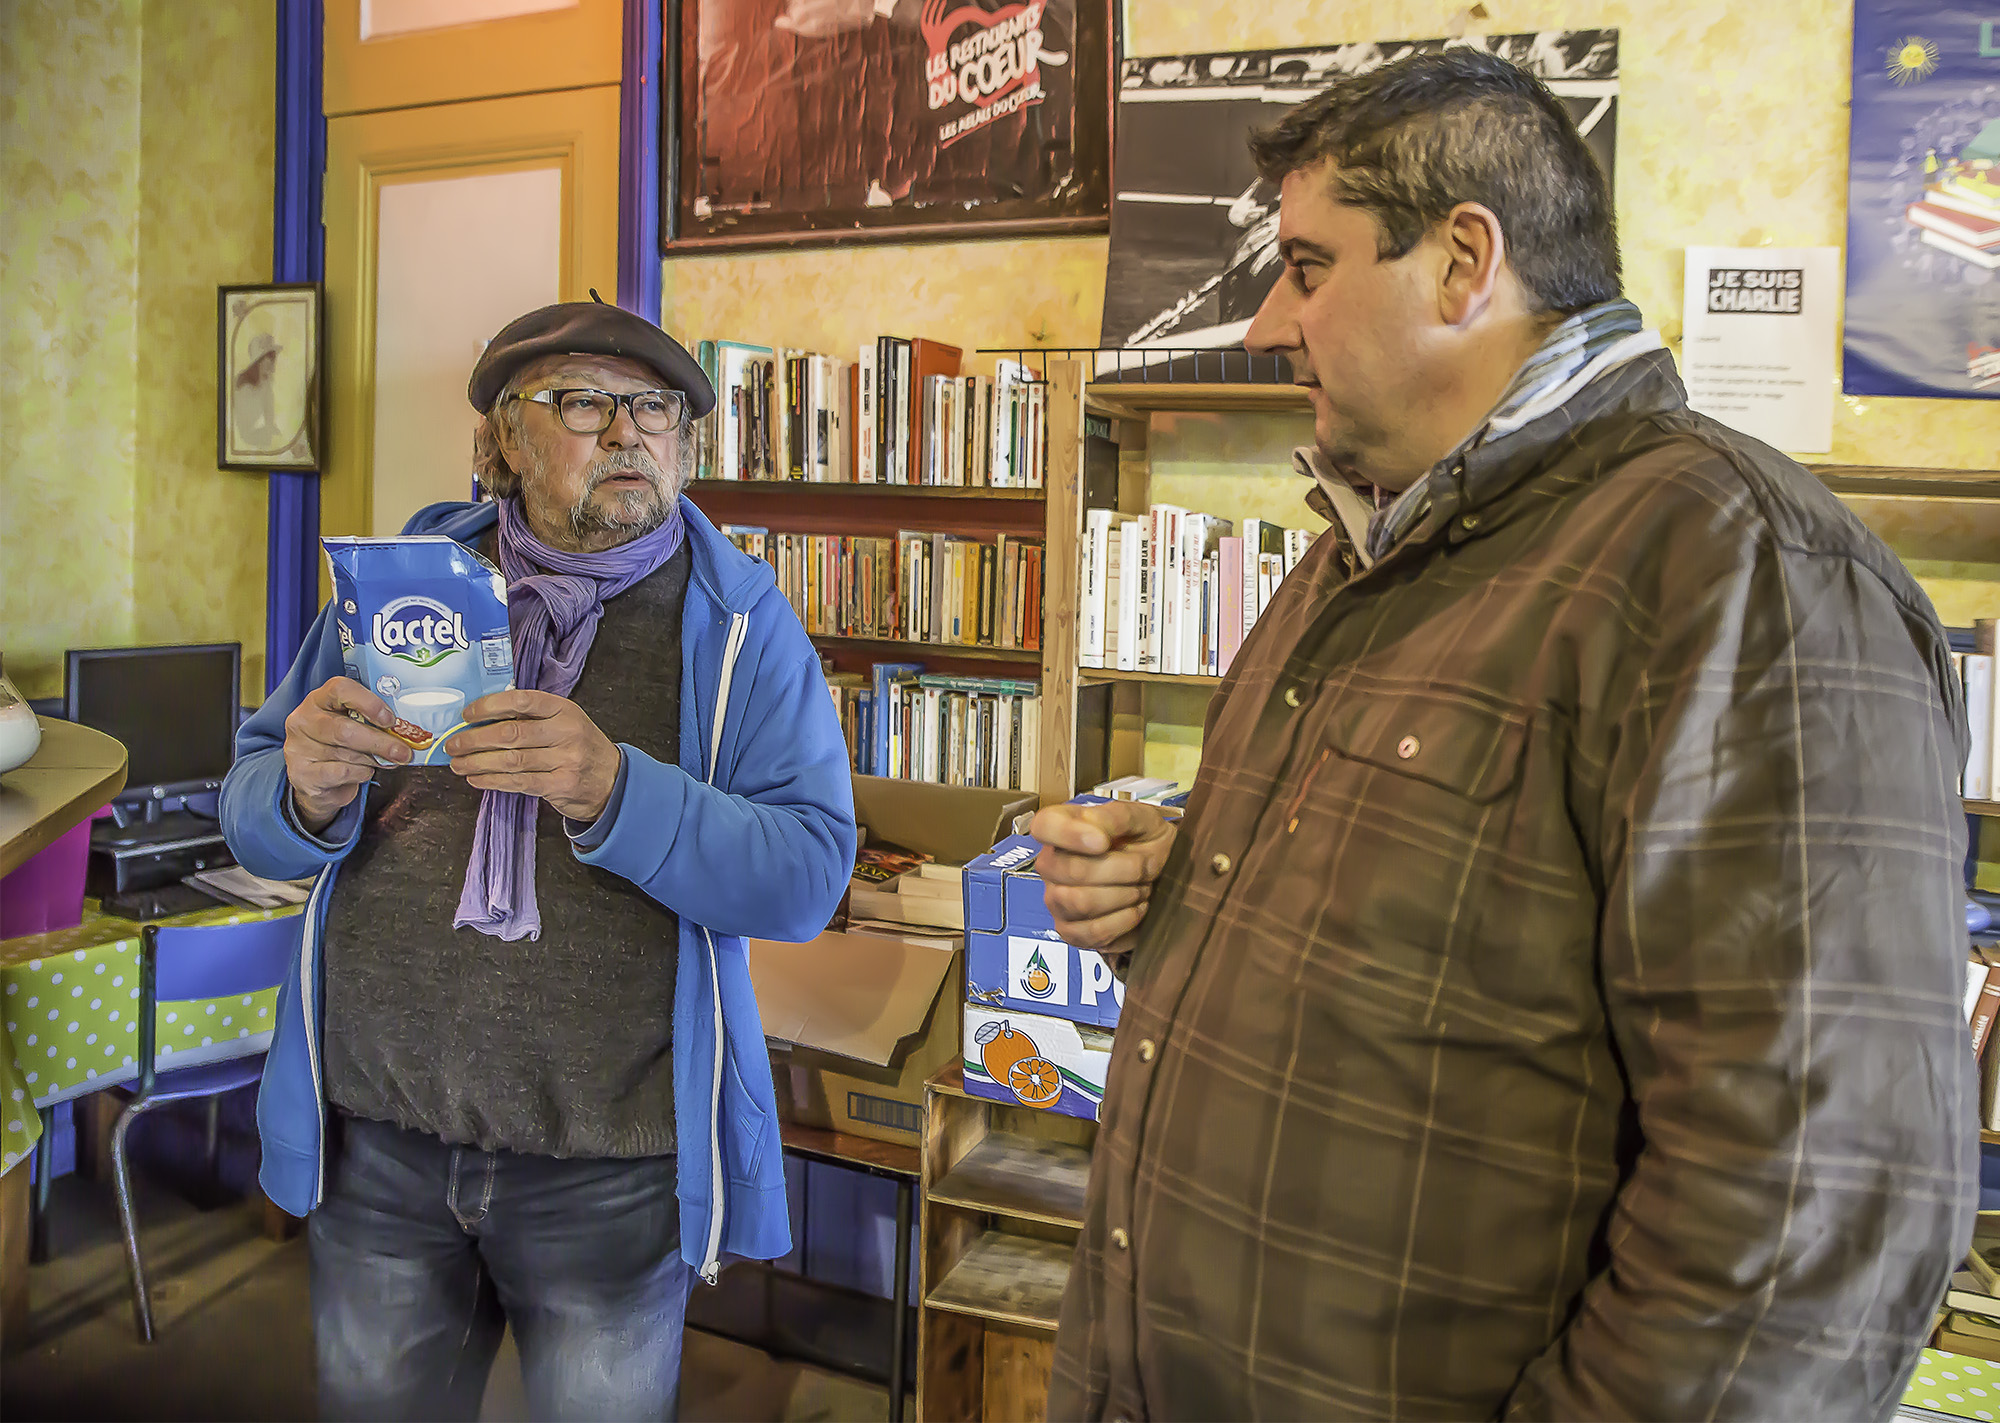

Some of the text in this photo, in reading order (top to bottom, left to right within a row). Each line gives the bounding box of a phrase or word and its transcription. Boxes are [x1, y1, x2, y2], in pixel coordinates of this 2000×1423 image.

[926, 2, 1041, 81] LES RESTAURANTS
[928, 71, 957, 110] DU
[939, 120, 957, 141] LES
[1710, 270, 1801, 289] JE SUIS
[1710, 288, 1800, 312] CHARLIE
